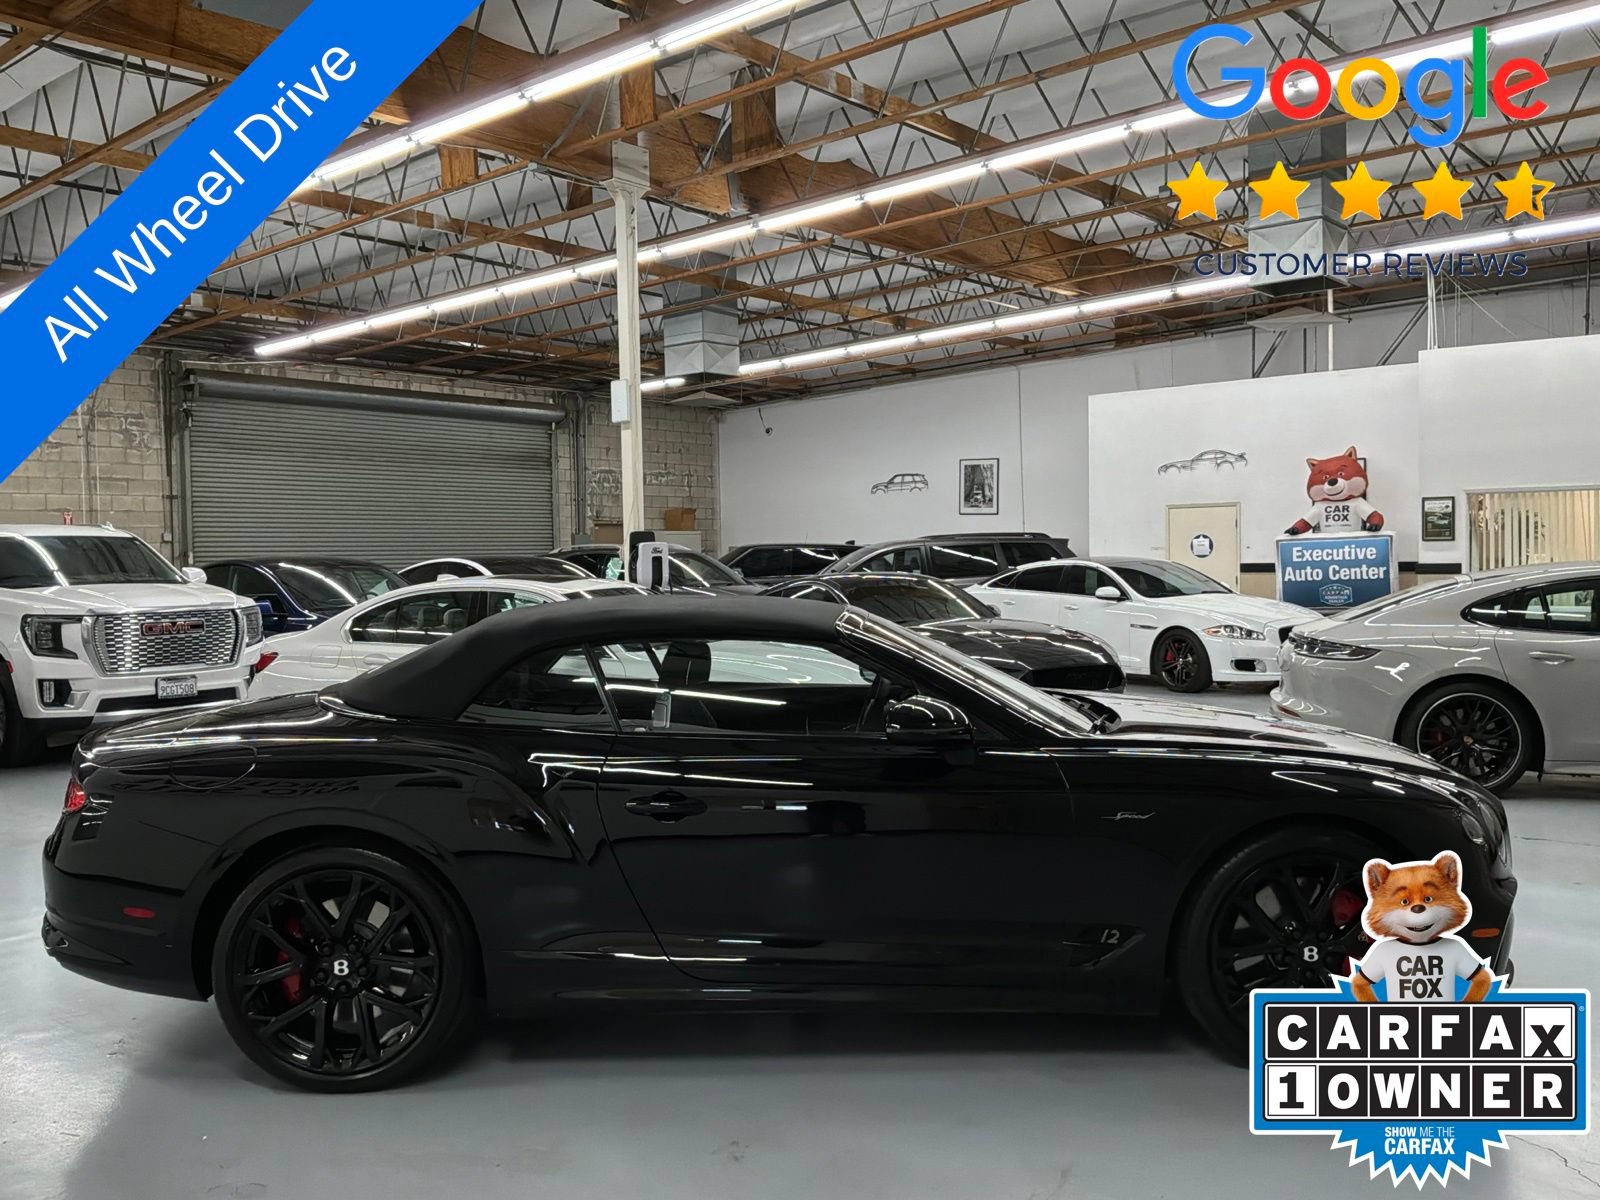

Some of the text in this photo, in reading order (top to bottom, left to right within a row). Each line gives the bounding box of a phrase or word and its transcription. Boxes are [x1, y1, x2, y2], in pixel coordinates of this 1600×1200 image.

[1324, 505, 1350, 514] CAR
[1325, 513, 1349, 522] FOX
[1292, 545, 1377, 562] Executive
[1284, 564, 1387, 581] Auto Center
[143, 621, 204, 635] GMC
[1100, 929, 1120, 944] 12
[1303, 945, 1319, 962] B
[333, 959, 349, 976] B
